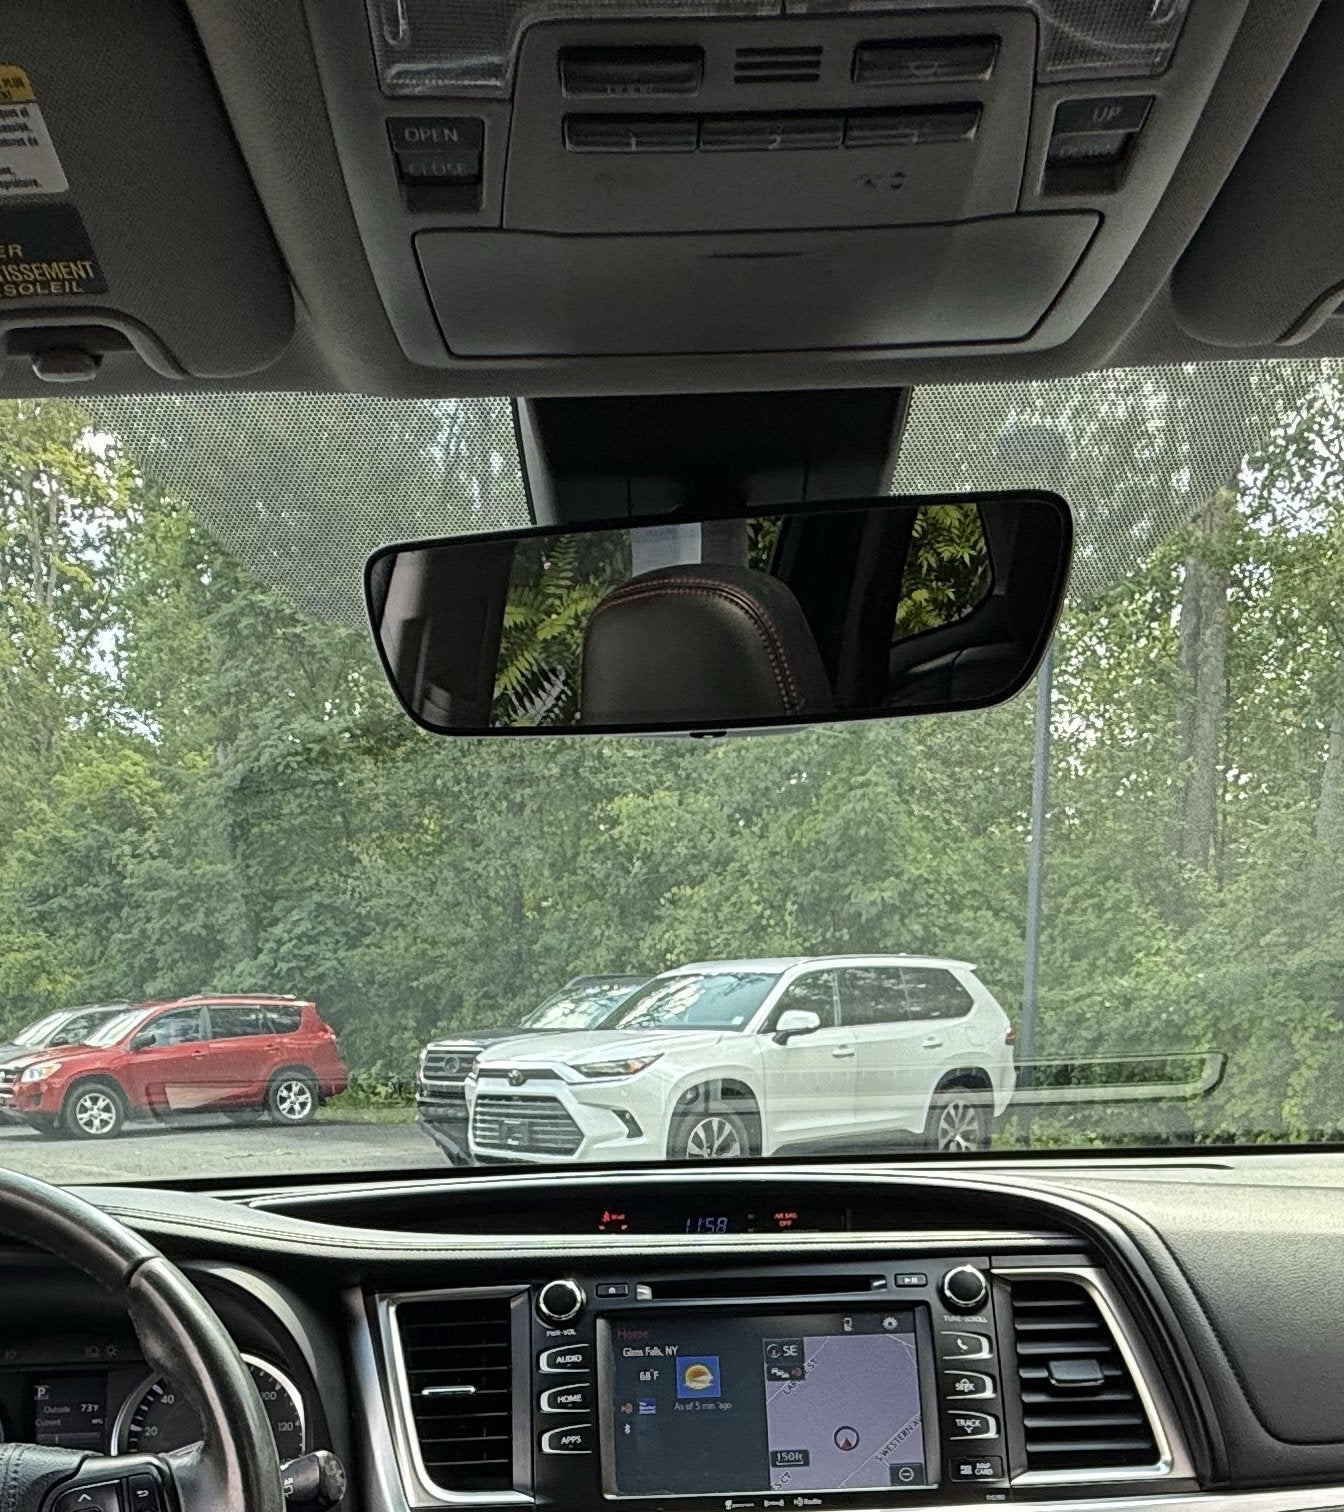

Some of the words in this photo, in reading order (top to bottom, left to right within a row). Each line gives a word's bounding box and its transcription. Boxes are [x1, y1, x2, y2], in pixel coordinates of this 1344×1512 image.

[404, 128, 459, 142] OPEN
[665, 1345, 679, 1356] NY
[782, 1345, 799, 1357] SE
[556, 1354, 583, 1364] AUDIO
[160, 1394, 175, 1404] 40
[557, 1394, 582, 1404] HOME
[674, 1402, 684, 1411] As
[277, 1421, 294, 1432] 120
[955, 1419, 981, 1427] TRACK
[144, 1425, 158, 1436] 20
[561, 1436, 582, 1445] APPS
[881, 1424, 915, 1457] WESTERN
[776, 1452, 804, 1462] 150ft
